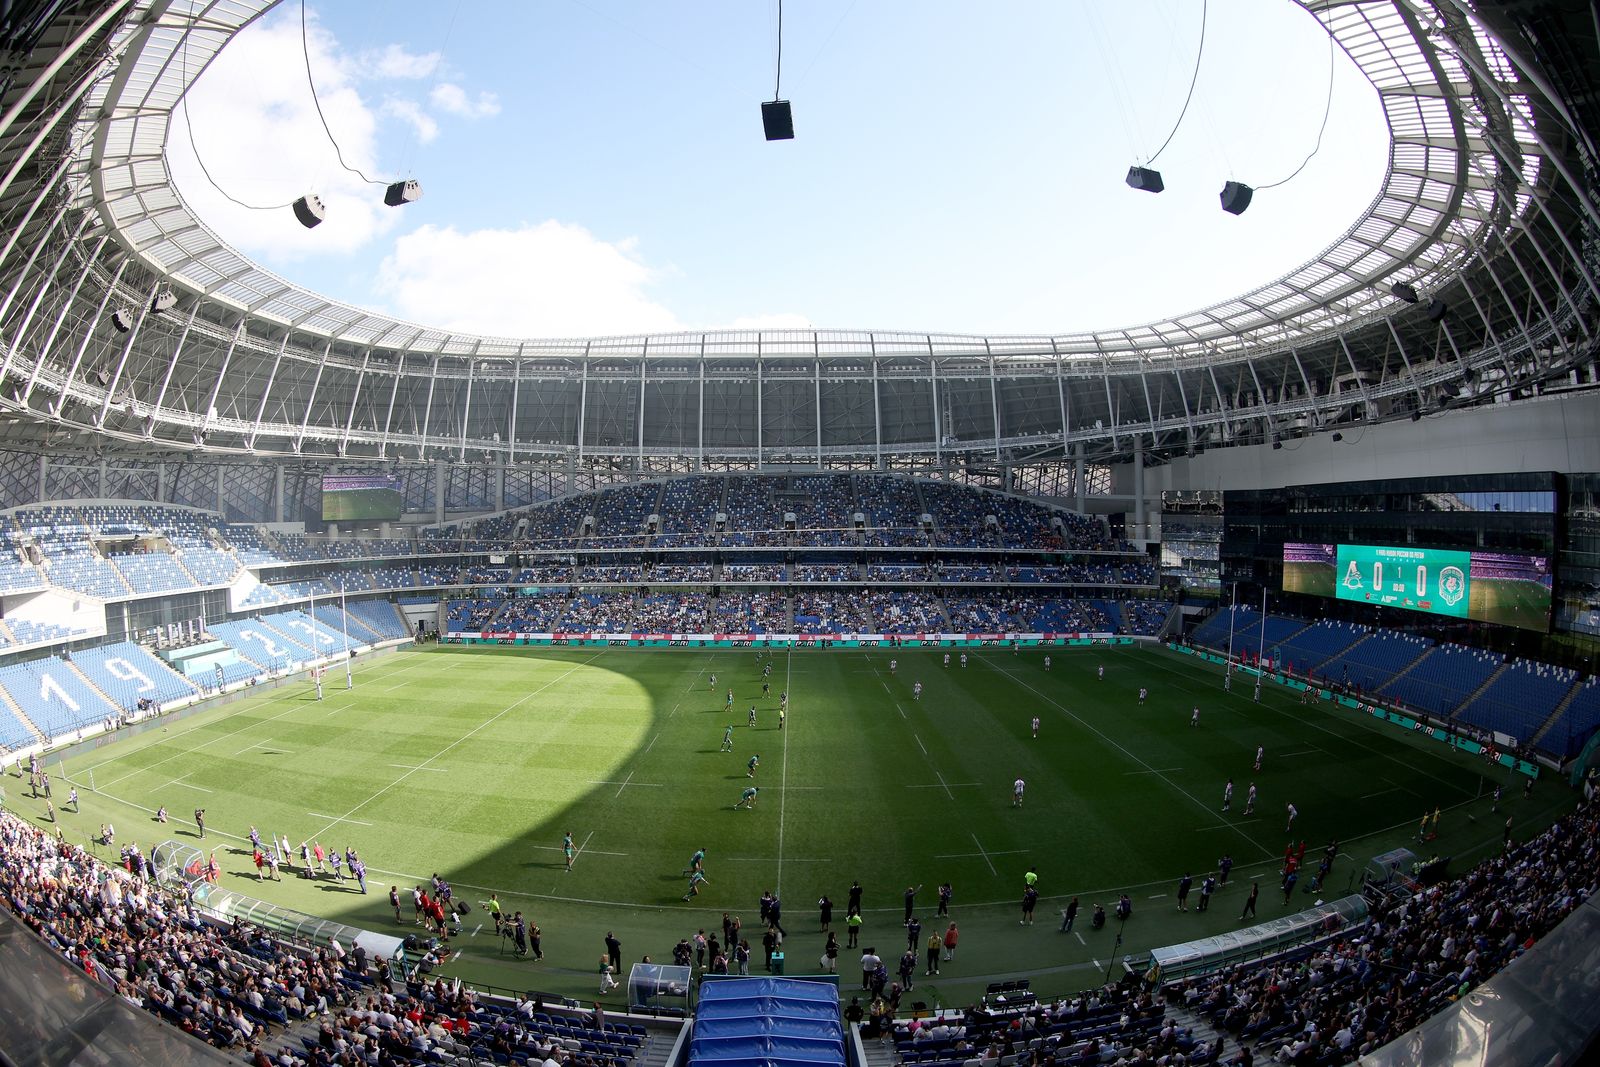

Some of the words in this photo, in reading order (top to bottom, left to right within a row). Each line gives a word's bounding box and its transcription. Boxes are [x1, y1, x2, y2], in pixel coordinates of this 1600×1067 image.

[1374, 562, 1383, 591] 0
[1398, 566, 1402, 579] 1
[1416, 565, 1427, 597] 0
[1479, 746, 1501, 761] PRI
